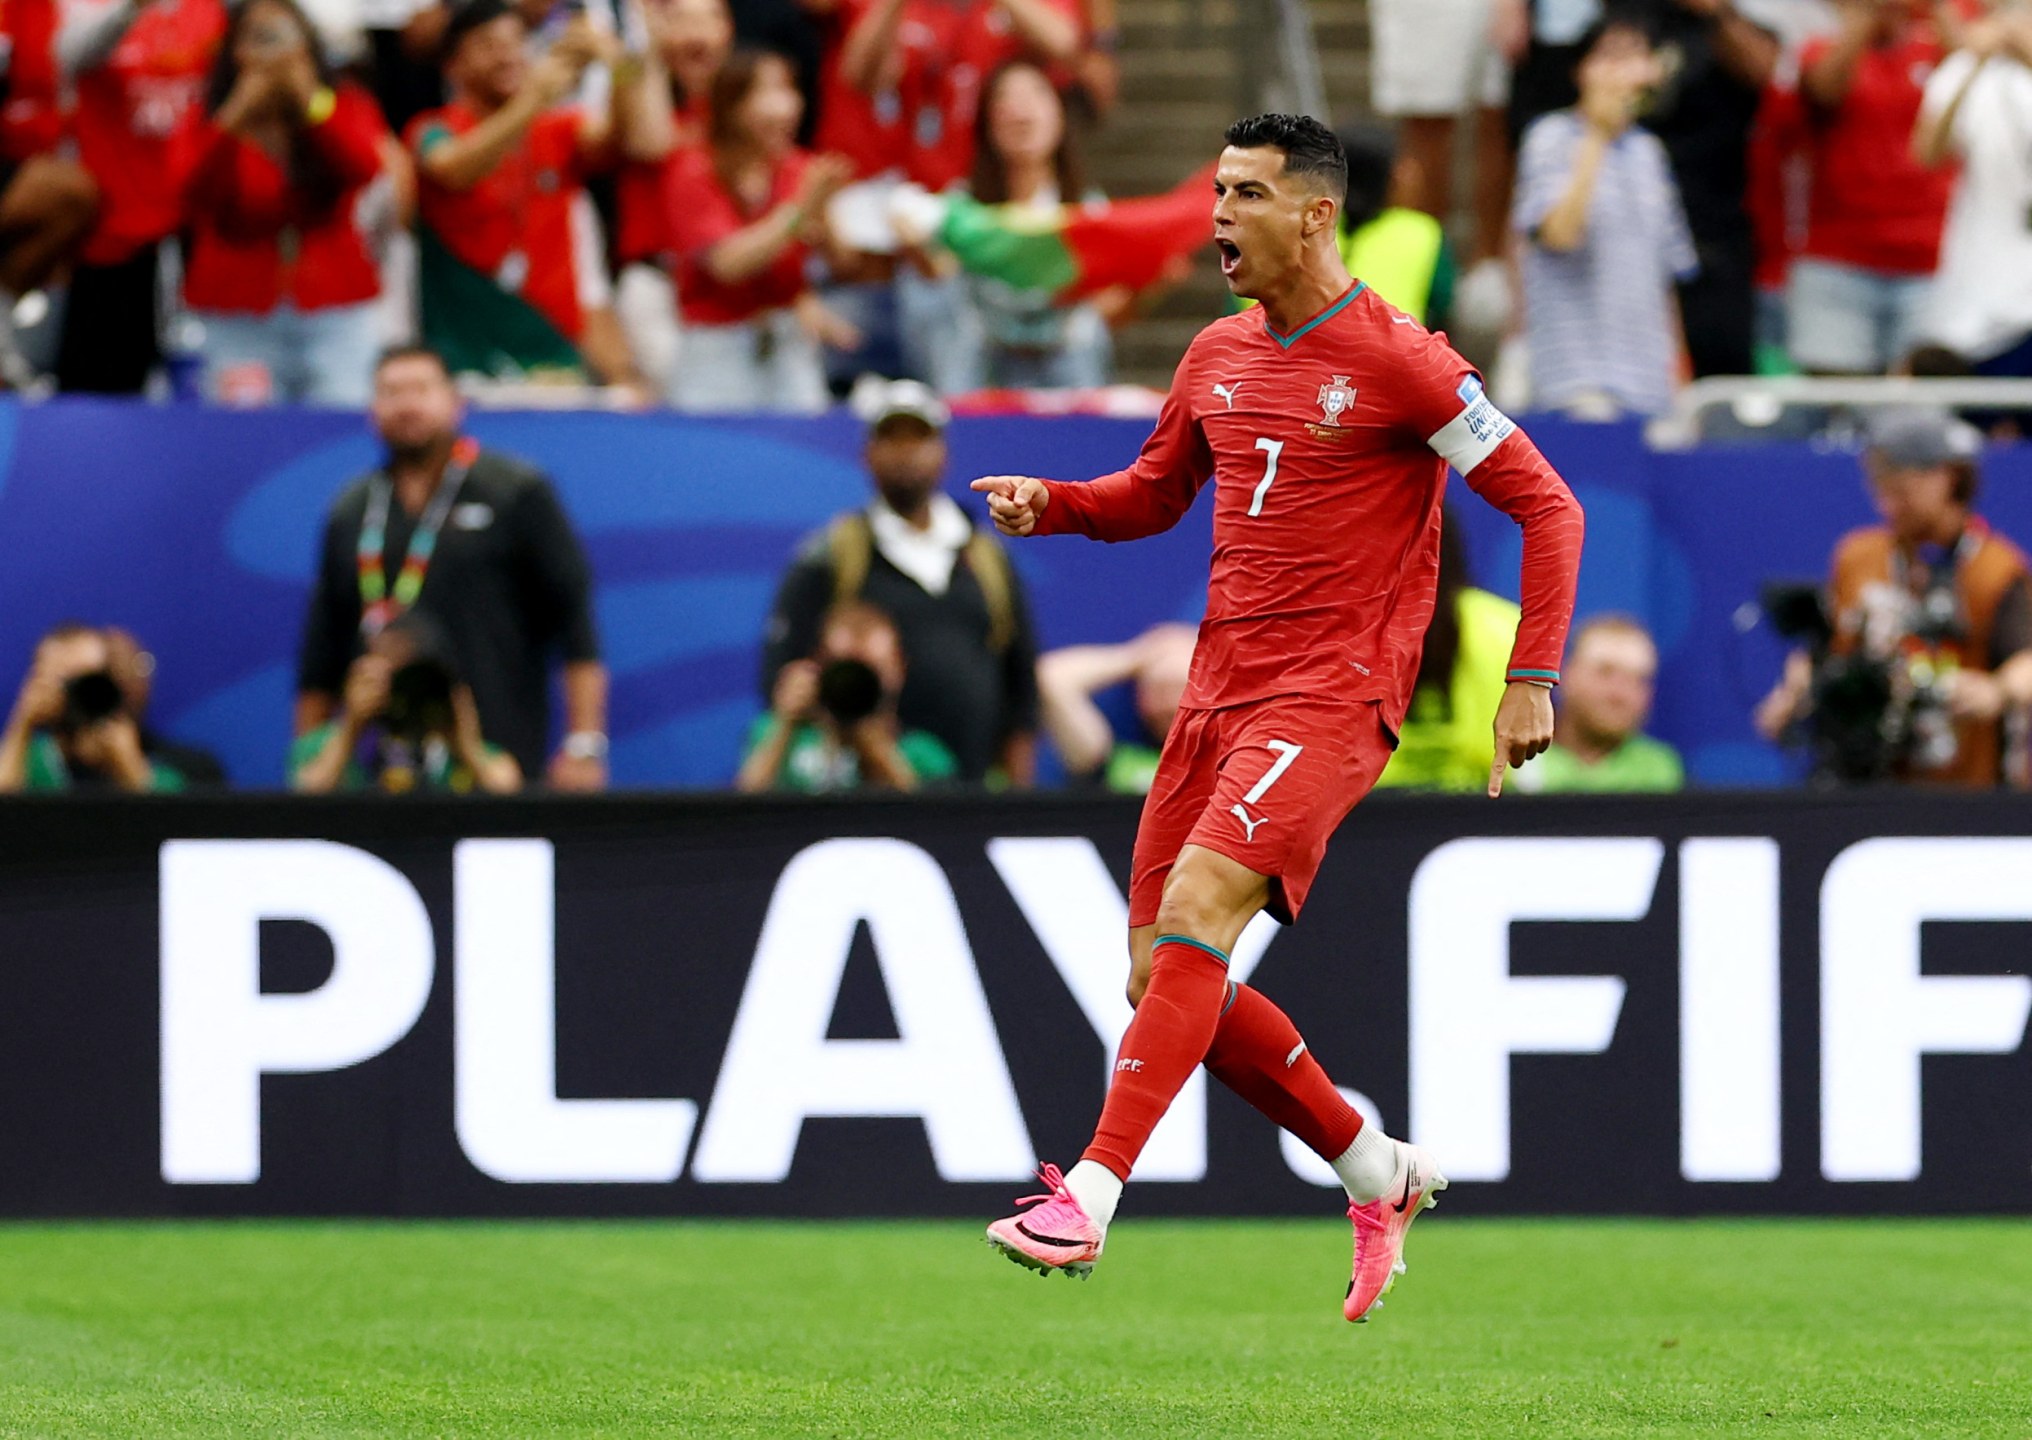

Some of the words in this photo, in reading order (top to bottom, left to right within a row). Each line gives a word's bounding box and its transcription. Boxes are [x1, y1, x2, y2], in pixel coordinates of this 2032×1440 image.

[1247, 437, 1285, 517] 7
[1242, 739, 1304, 804] 7
[159, 837, 2032, 1184] PLAFIF
